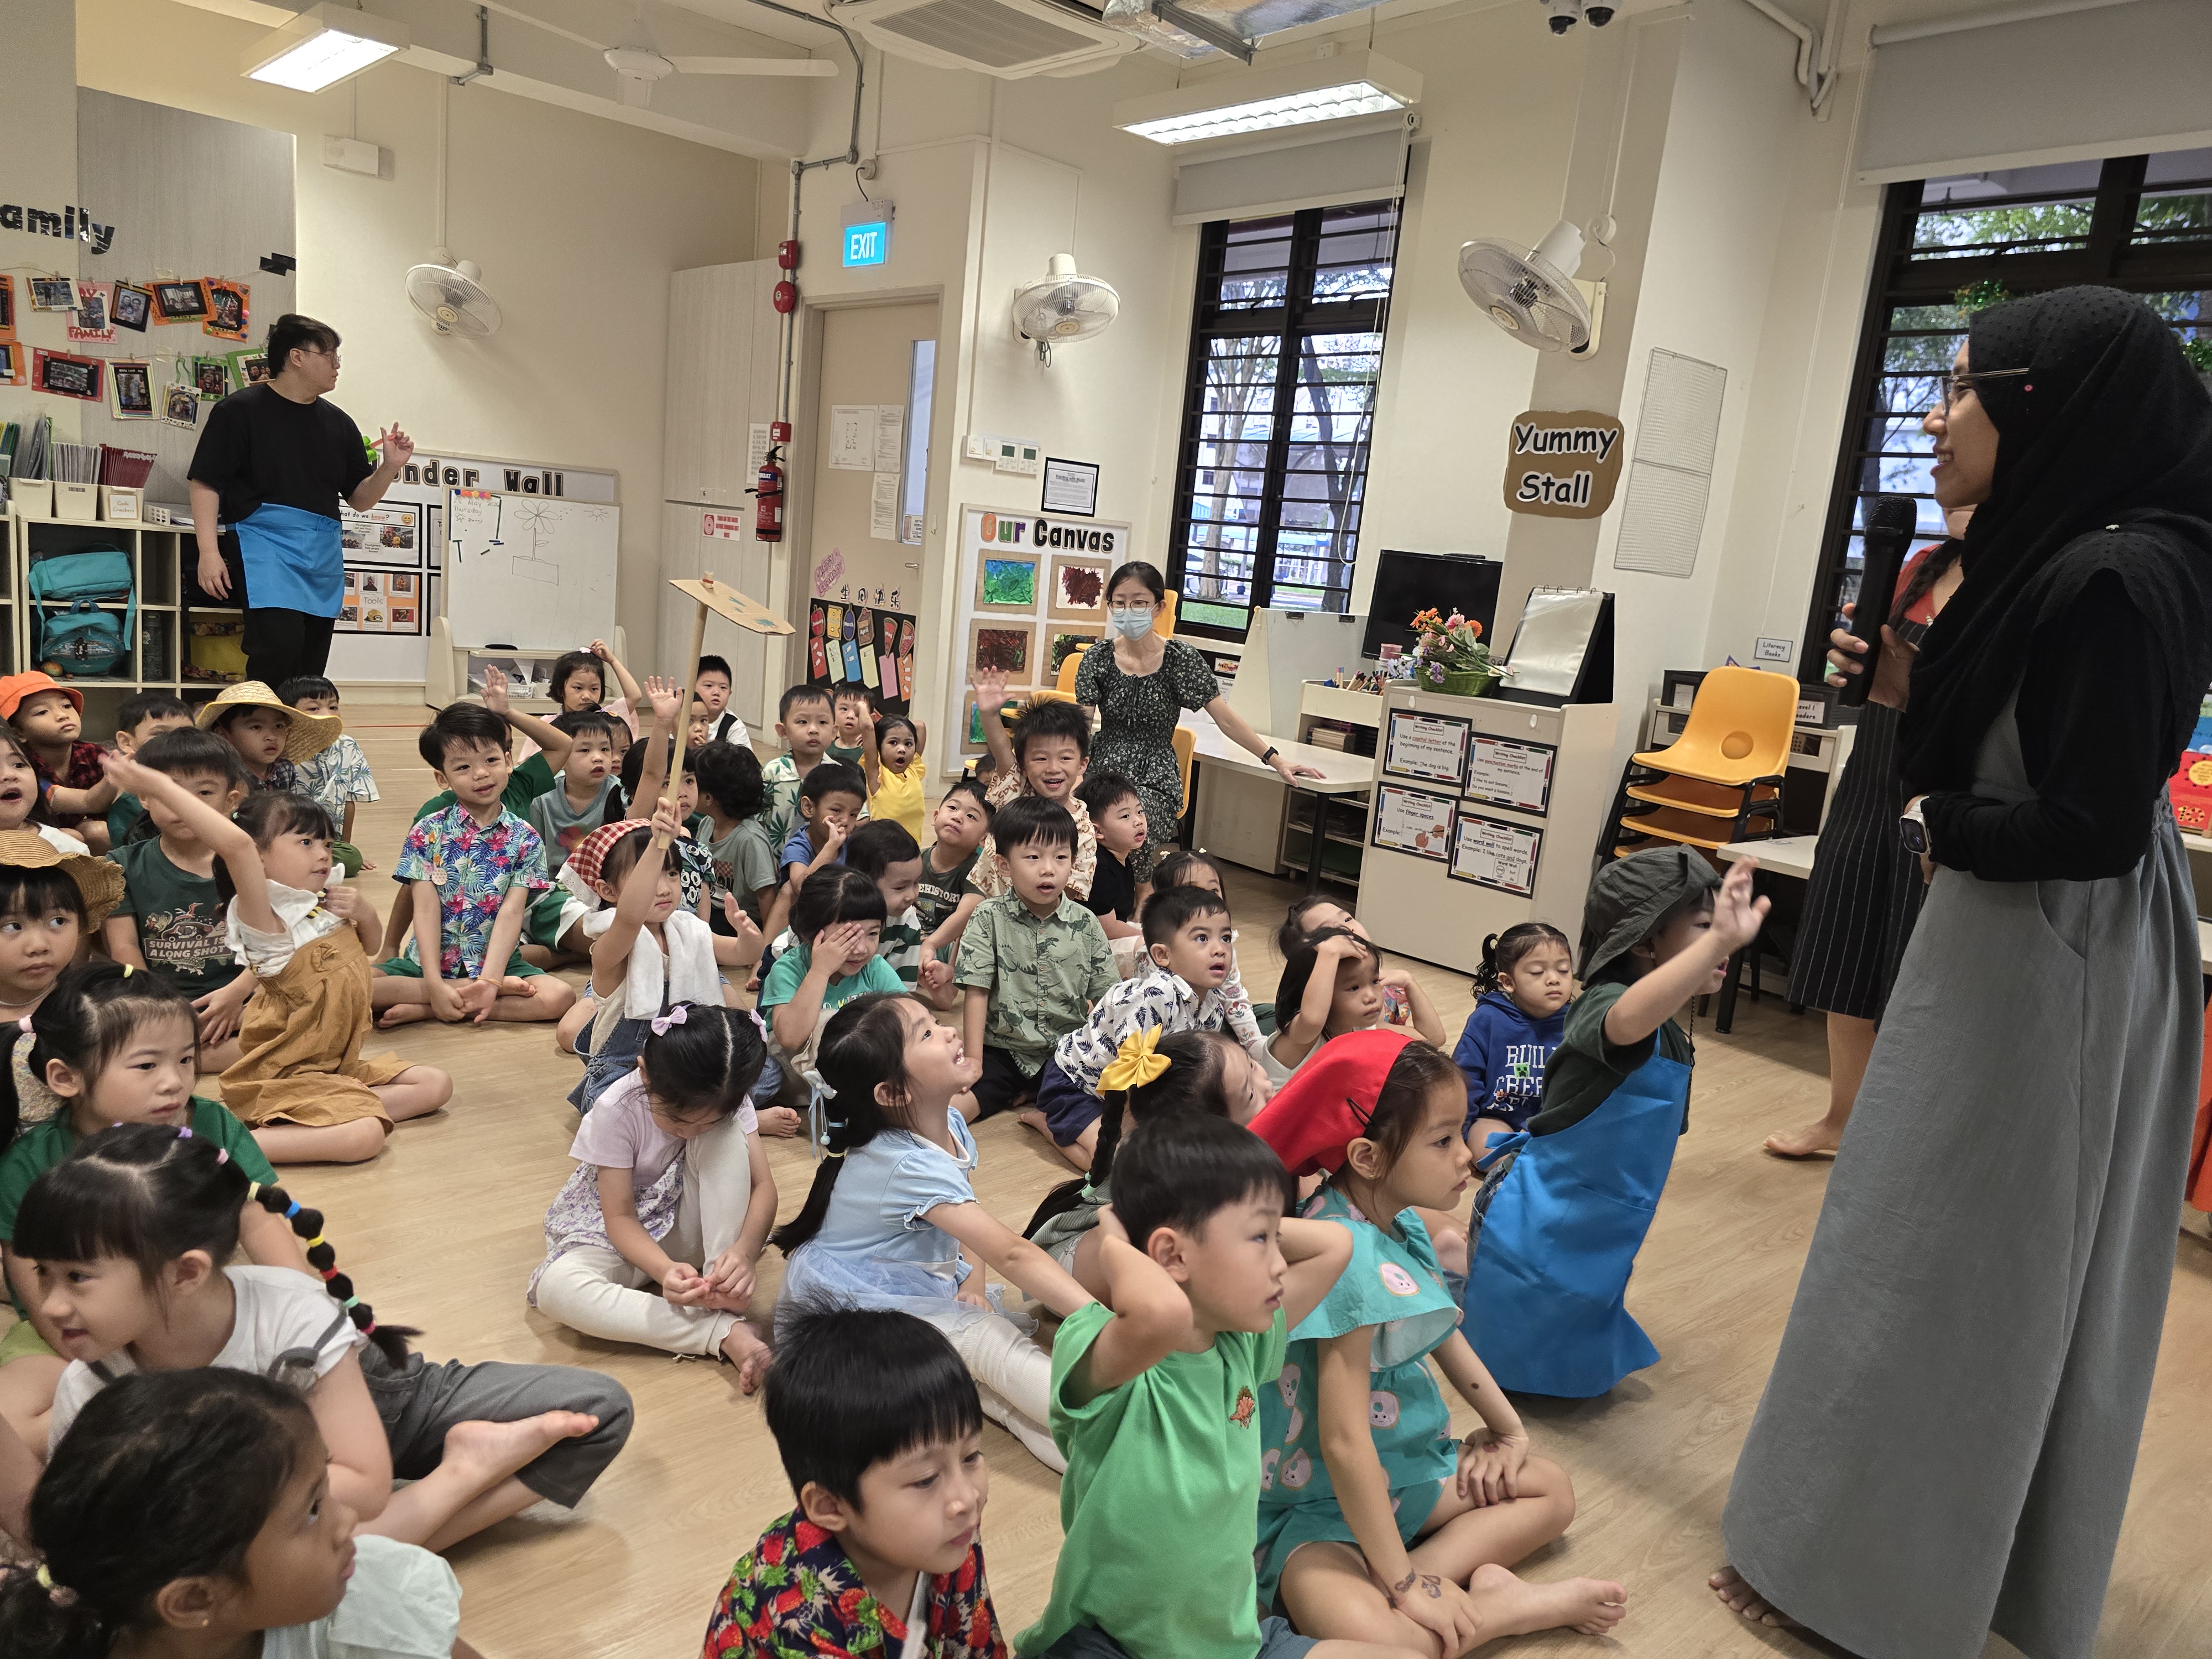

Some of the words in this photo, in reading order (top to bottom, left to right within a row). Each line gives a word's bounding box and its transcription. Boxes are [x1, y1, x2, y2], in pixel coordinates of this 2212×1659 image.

[0, 205, 115, 254] amily
[851, 232, 877, 259] EXIT
[1516, 425, 1617, 459] Yummy
[394, 460, 478, 487] nder
[504, 469, 563, 496] Wall
[1520, 474, 1589, 503] Stall
[454, 506, 482, 516] Thursday
[468, 499, 482, 508] May
[981, 512, 1026, 542] Our
[1034, 518, 1114, 553] Canvas
[859, 626, 869, 635] April
[1763, 641, 1785, 651] Literacy
[1400, 741, 1420, 750] beginning
[1462, 844, 1481, 853] Example:
[918, 883, 960, 902] EHISTOR
[149, 939, 210, 950] SURVIVAL
[159, 950, 191, 958] LONG
[194, 946, 226, 957] SHOT
[1505, 1044, 1547, 1068] BUIL
